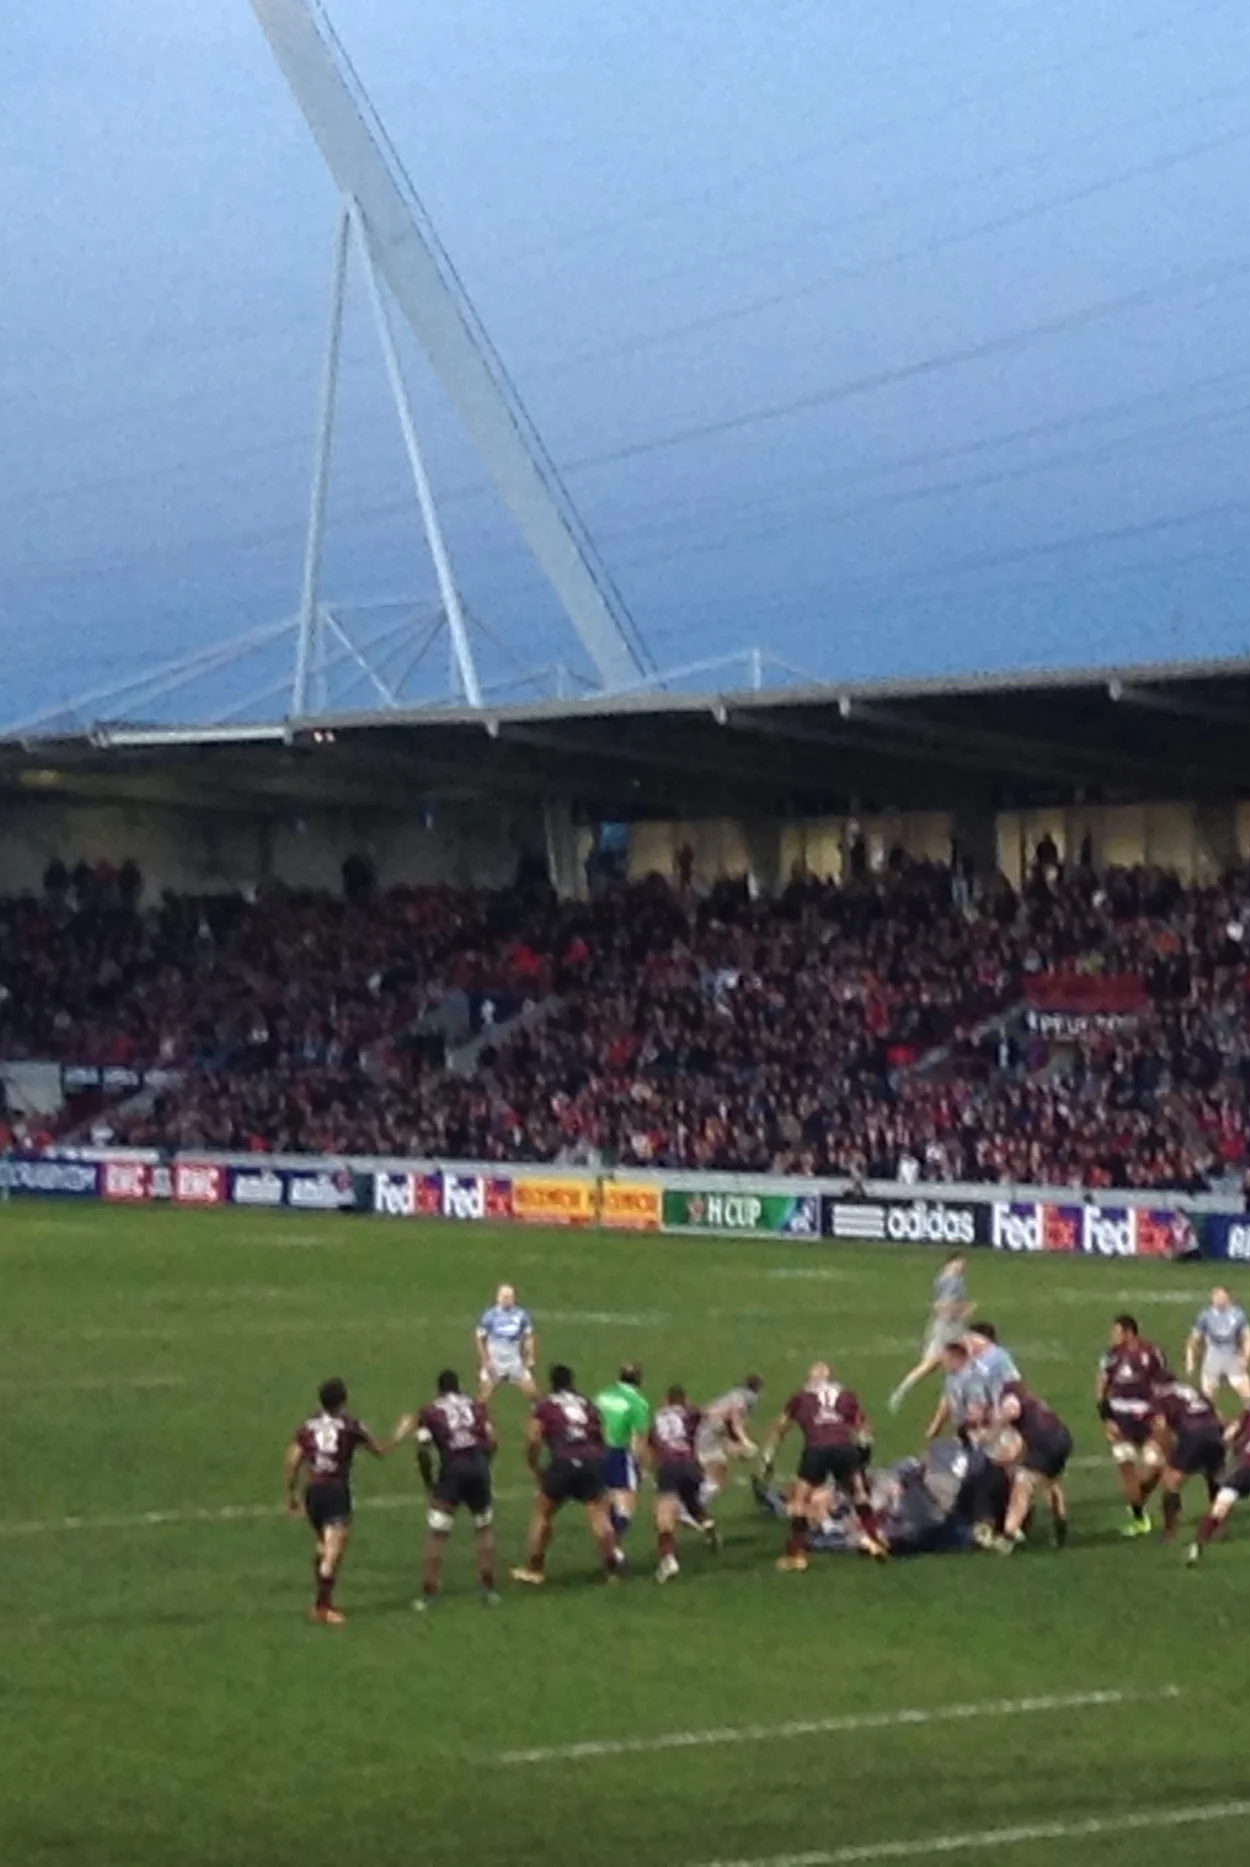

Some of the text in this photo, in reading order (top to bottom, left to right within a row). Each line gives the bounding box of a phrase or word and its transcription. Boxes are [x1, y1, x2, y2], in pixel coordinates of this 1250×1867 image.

[706, 1195, 763, 1229] H CUP
[887, 1201, 976, 1244] adidas
[992, 1202, 1078, 1251] FedEx
